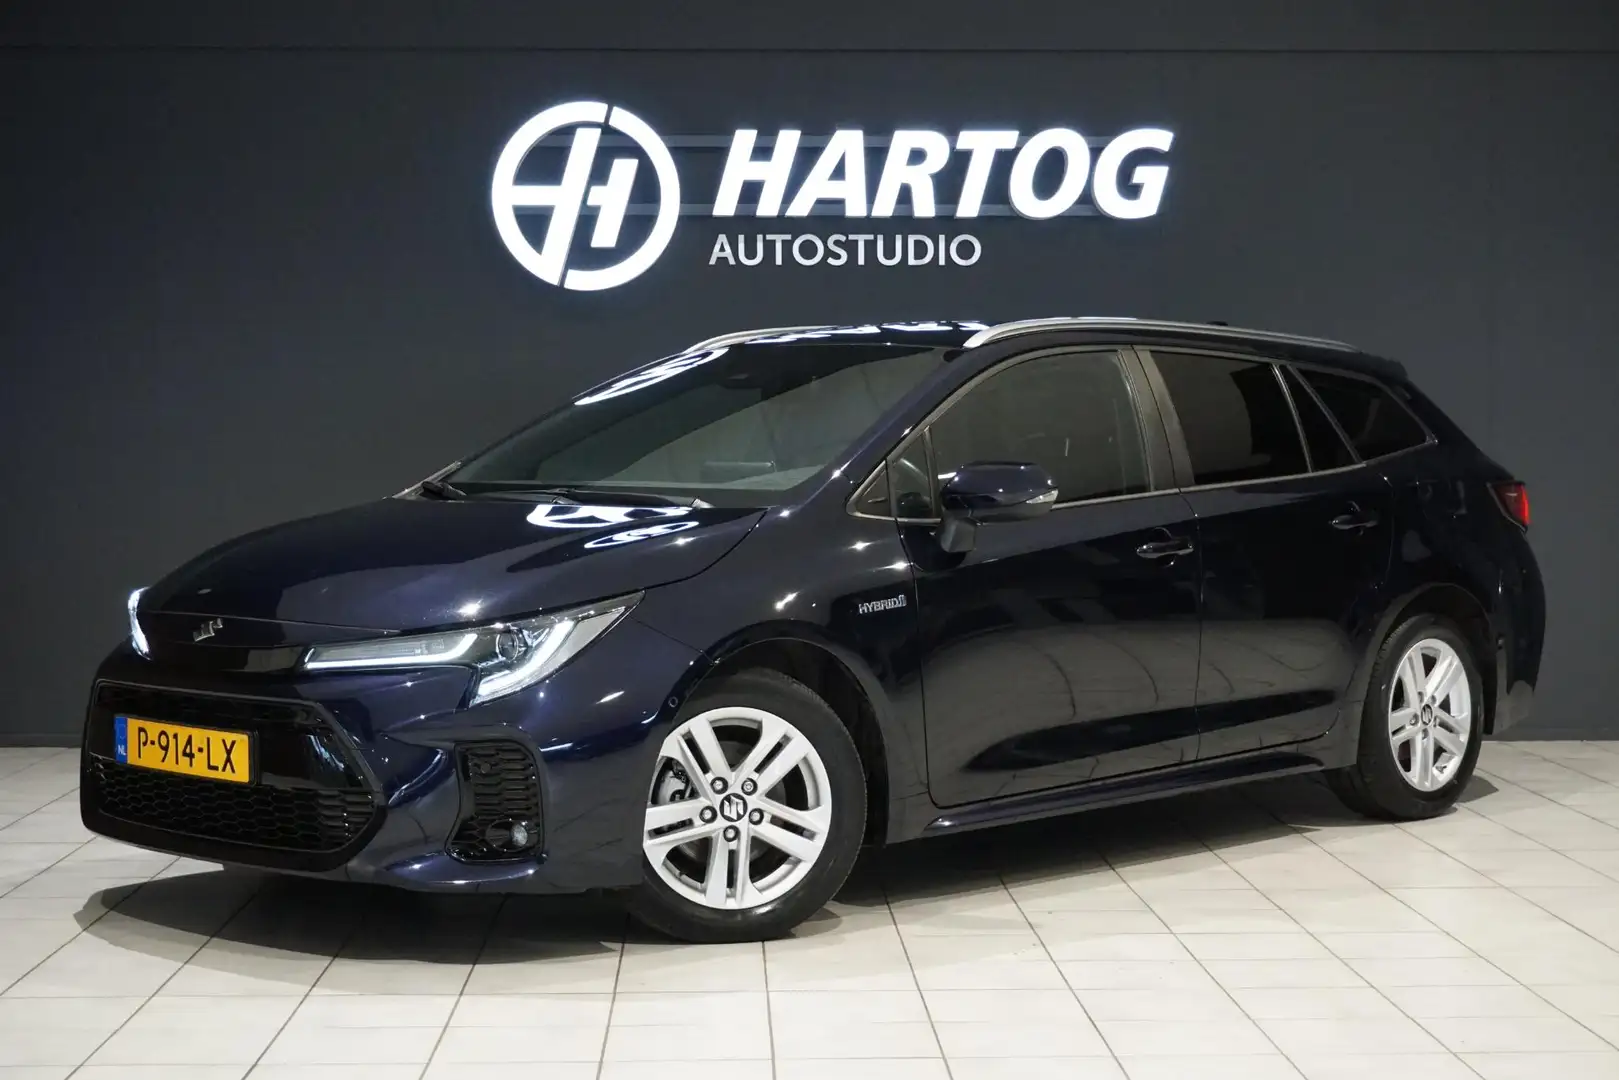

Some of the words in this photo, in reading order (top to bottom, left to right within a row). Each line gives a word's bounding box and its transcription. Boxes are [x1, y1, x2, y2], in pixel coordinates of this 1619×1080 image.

[712, 127, 1174, 220] HARTOG
[708, 233, 982, 268] AUTOSTUDIO
[117, 744, 128, 756] NL
[137, 726, 237, 774] P-914-LX
